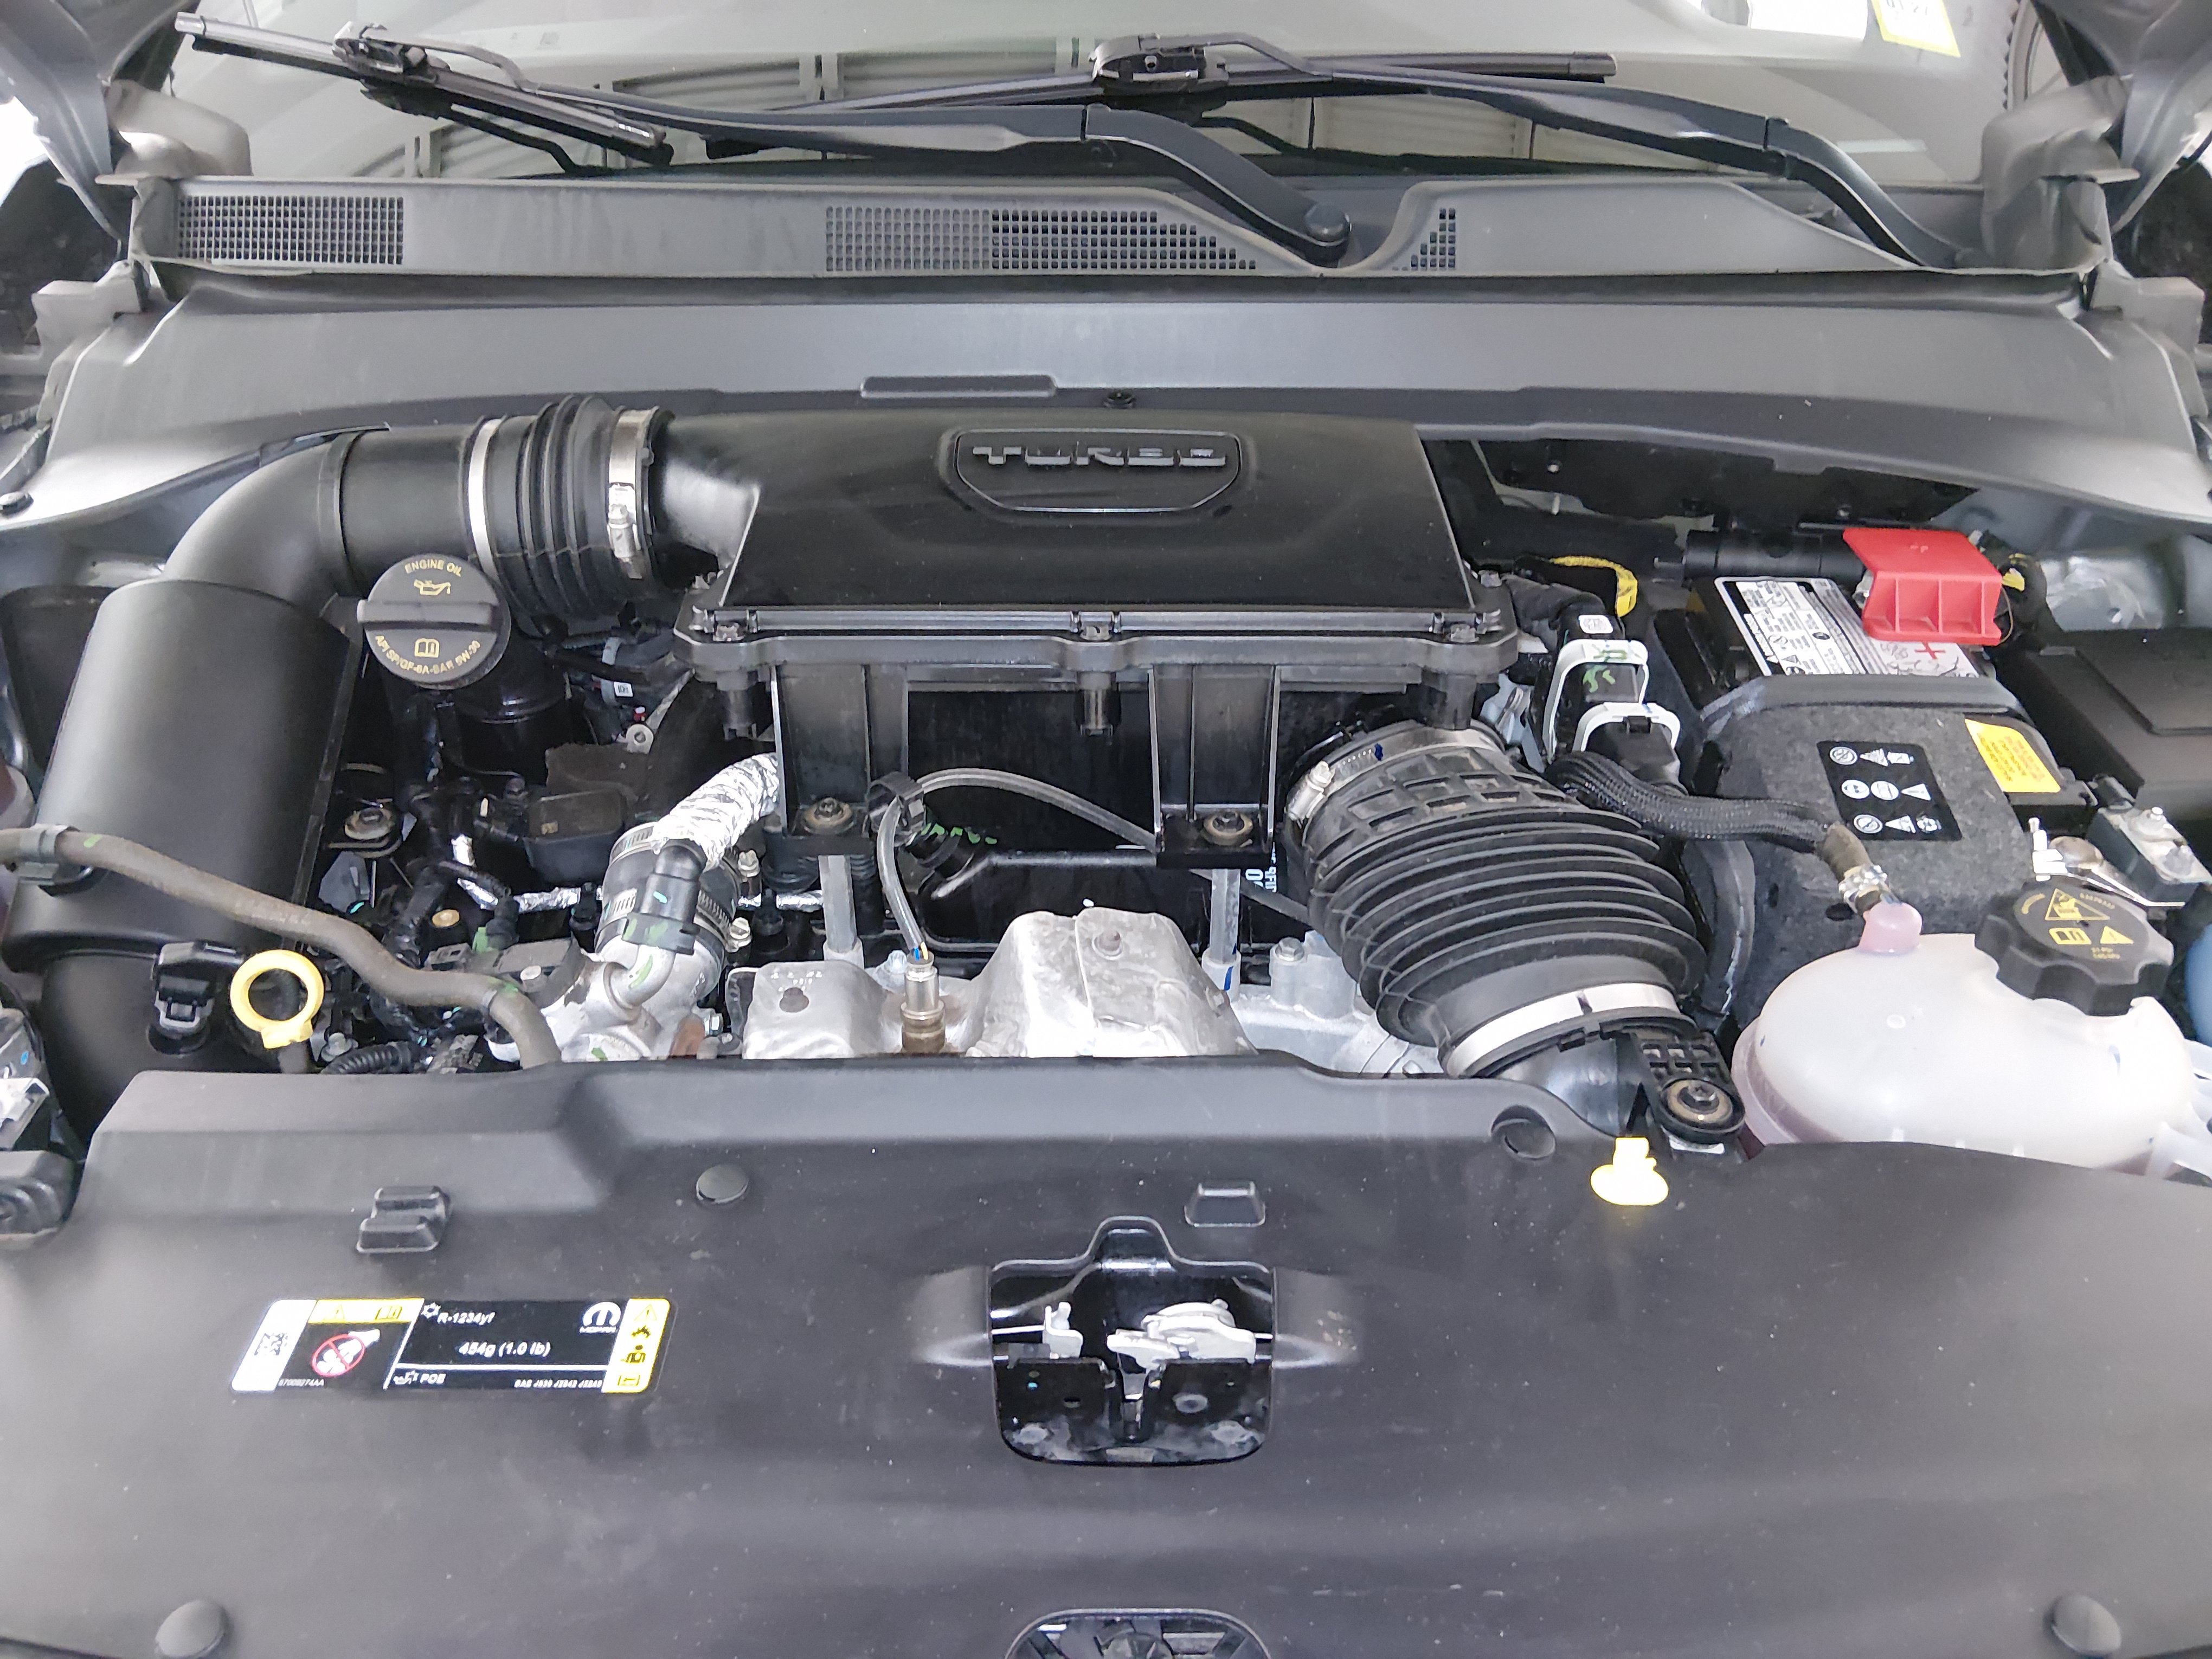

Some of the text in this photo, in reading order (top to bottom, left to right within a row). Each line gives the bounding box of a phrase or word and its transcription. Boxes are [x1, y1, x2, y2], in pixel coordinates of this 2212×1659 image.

[973, 446, 1226, 467] TURBO
[404, 558, 462, 577] ENGINE OIL
[375, 635, 390, 652] API
[438, 1311, 496, 1326] R-1234yf
[458, 1341, 551, 1358] 454g (1.0 lb)
